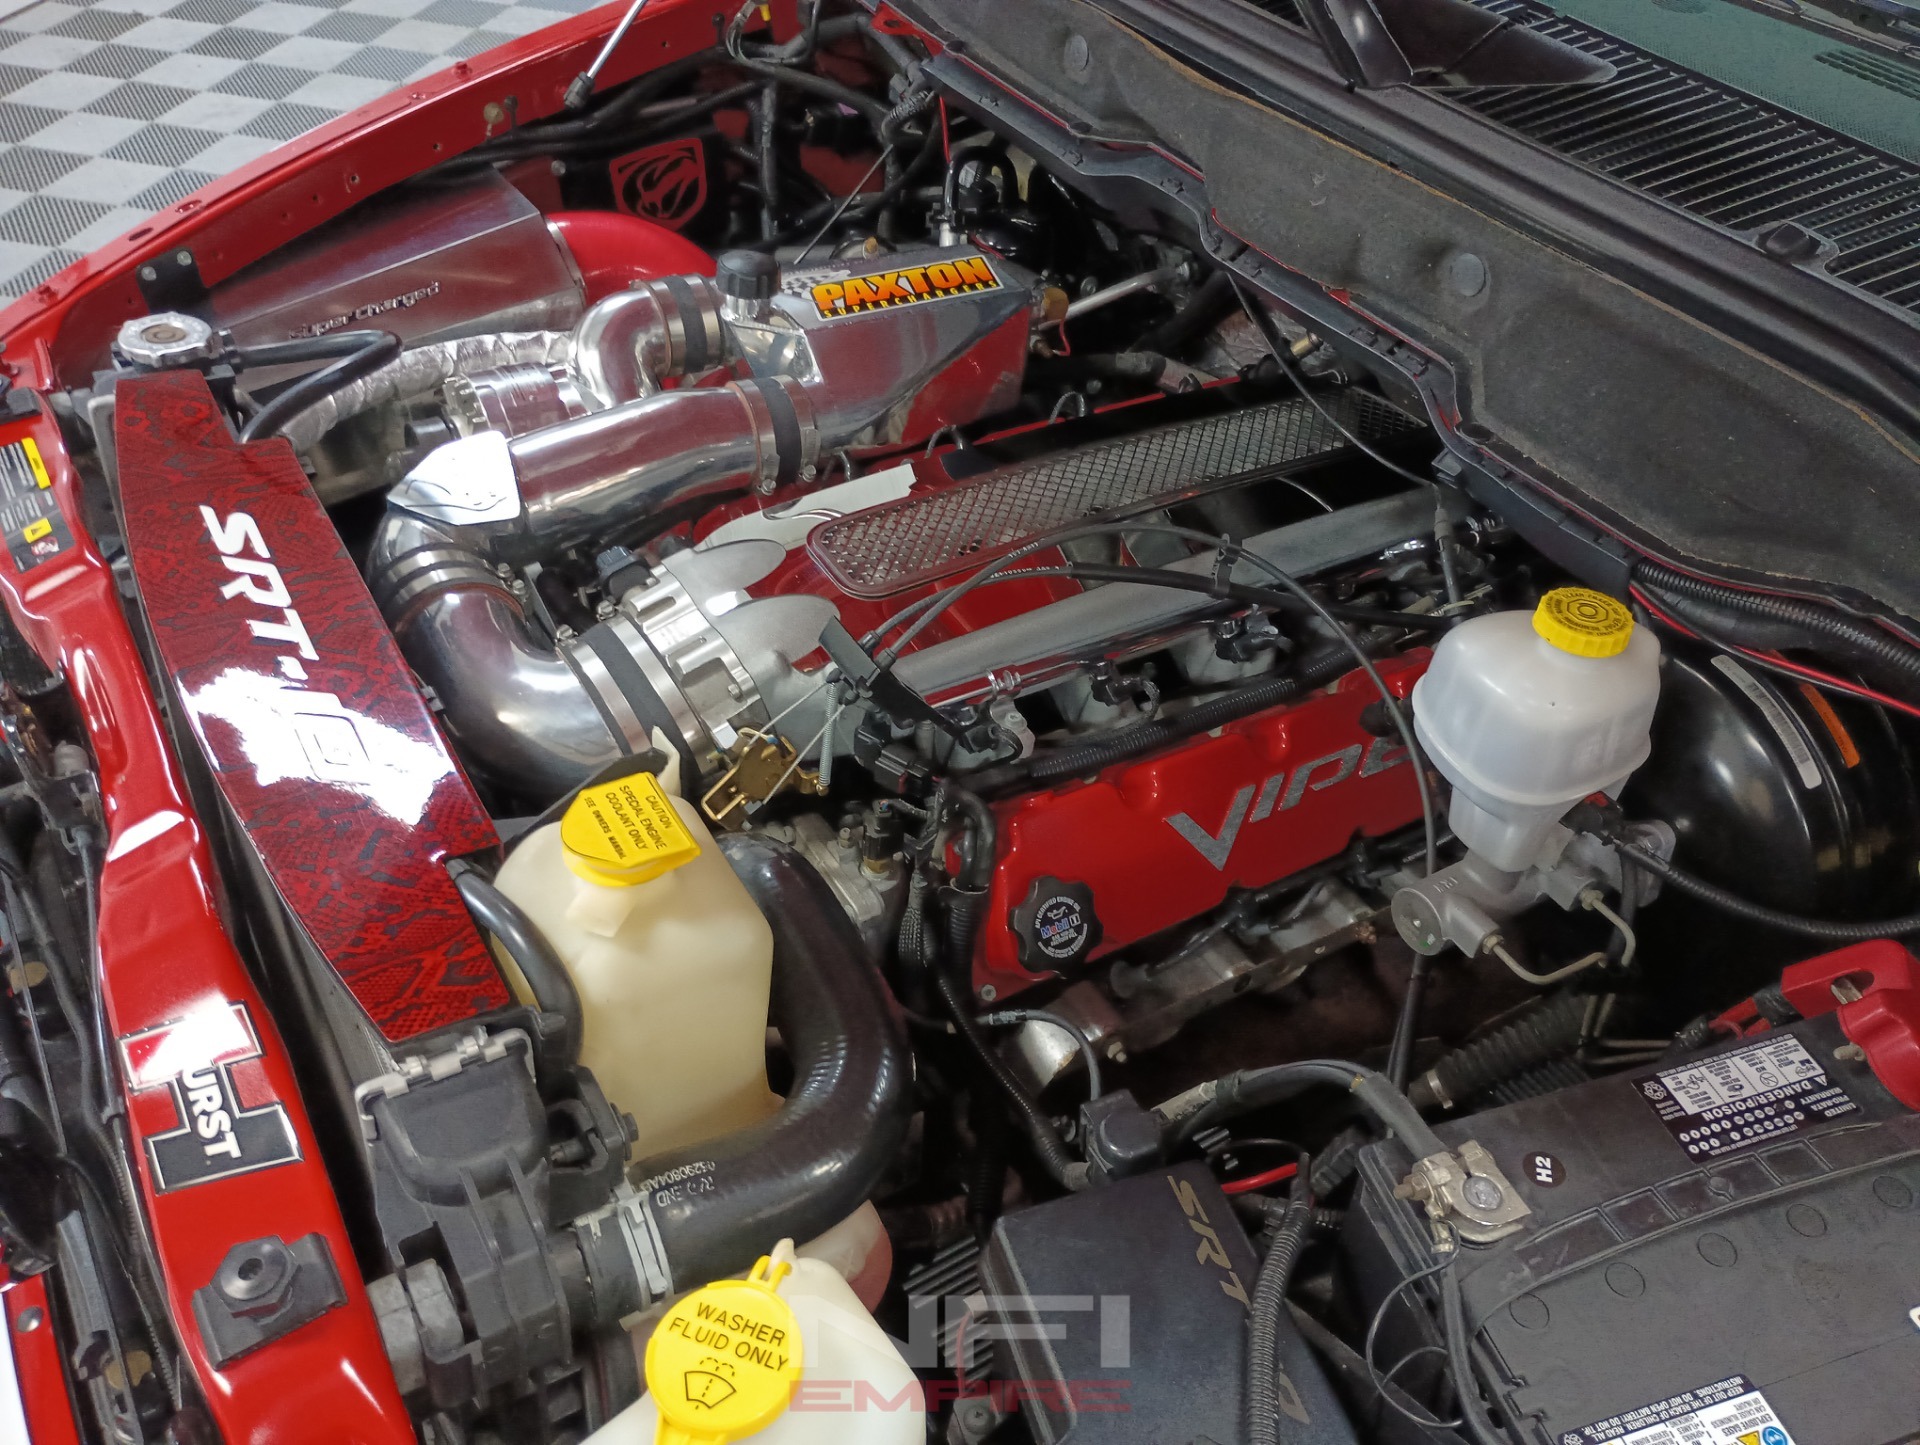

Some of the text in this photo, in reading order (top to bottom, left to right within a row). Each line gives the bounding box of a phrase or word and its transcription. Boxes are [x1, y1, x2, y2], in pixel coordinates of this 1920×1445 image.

[811, 257, 995, 311] PAXTON
[823, 280, 998, 318] SUPERCHARGERS
[619, 785, 668, 851] SPECIAL ENGINE
[645, 794, 674, 830] CAUTION
[605, 792, 650, 850] COOLANT ONLY
[1040, 917, 1070, 939] Mobil
[1701, 1080, 1812, 1121] DANGER/POISON
[1800, 1087, 1842, 1104] WARRANTY
[1810, 1094, 1849, 1111] PRO-RATA
[1823, 1102, 1856, 1117] LIMITED
[1535, 1155, 1553, 1183] H2
[696, 1301, 786, 1347] WASHER
[668, 1316, 789, 1372] FLUID ONLY
[1711, 1390, 1727, 1401] OUT
[1726, 1385, 1744, 1396] KEEP
[1581, 1375, 1743, 1435] INSTRUCTIONS. DO NOT OPEN BATTERY! DO NOT TIP.
[1690, 1399, 1703, 1408] THE
[1702, 1395, 1712, 1404] OF
[1659, 1410, 1669, 1418] OF
[1669, 1403, 1690, 1415] REACH
[1737, 1408, 1755, 1419] CAUSE
[1754, 1404, 1766, 1413] CAN
[1605, 1425, 1624, 1437] READ
[1721, 1413, 1773, 1436] EXPLOSIVE GASES
[1591, 1431, 1605, 1441] ALL
